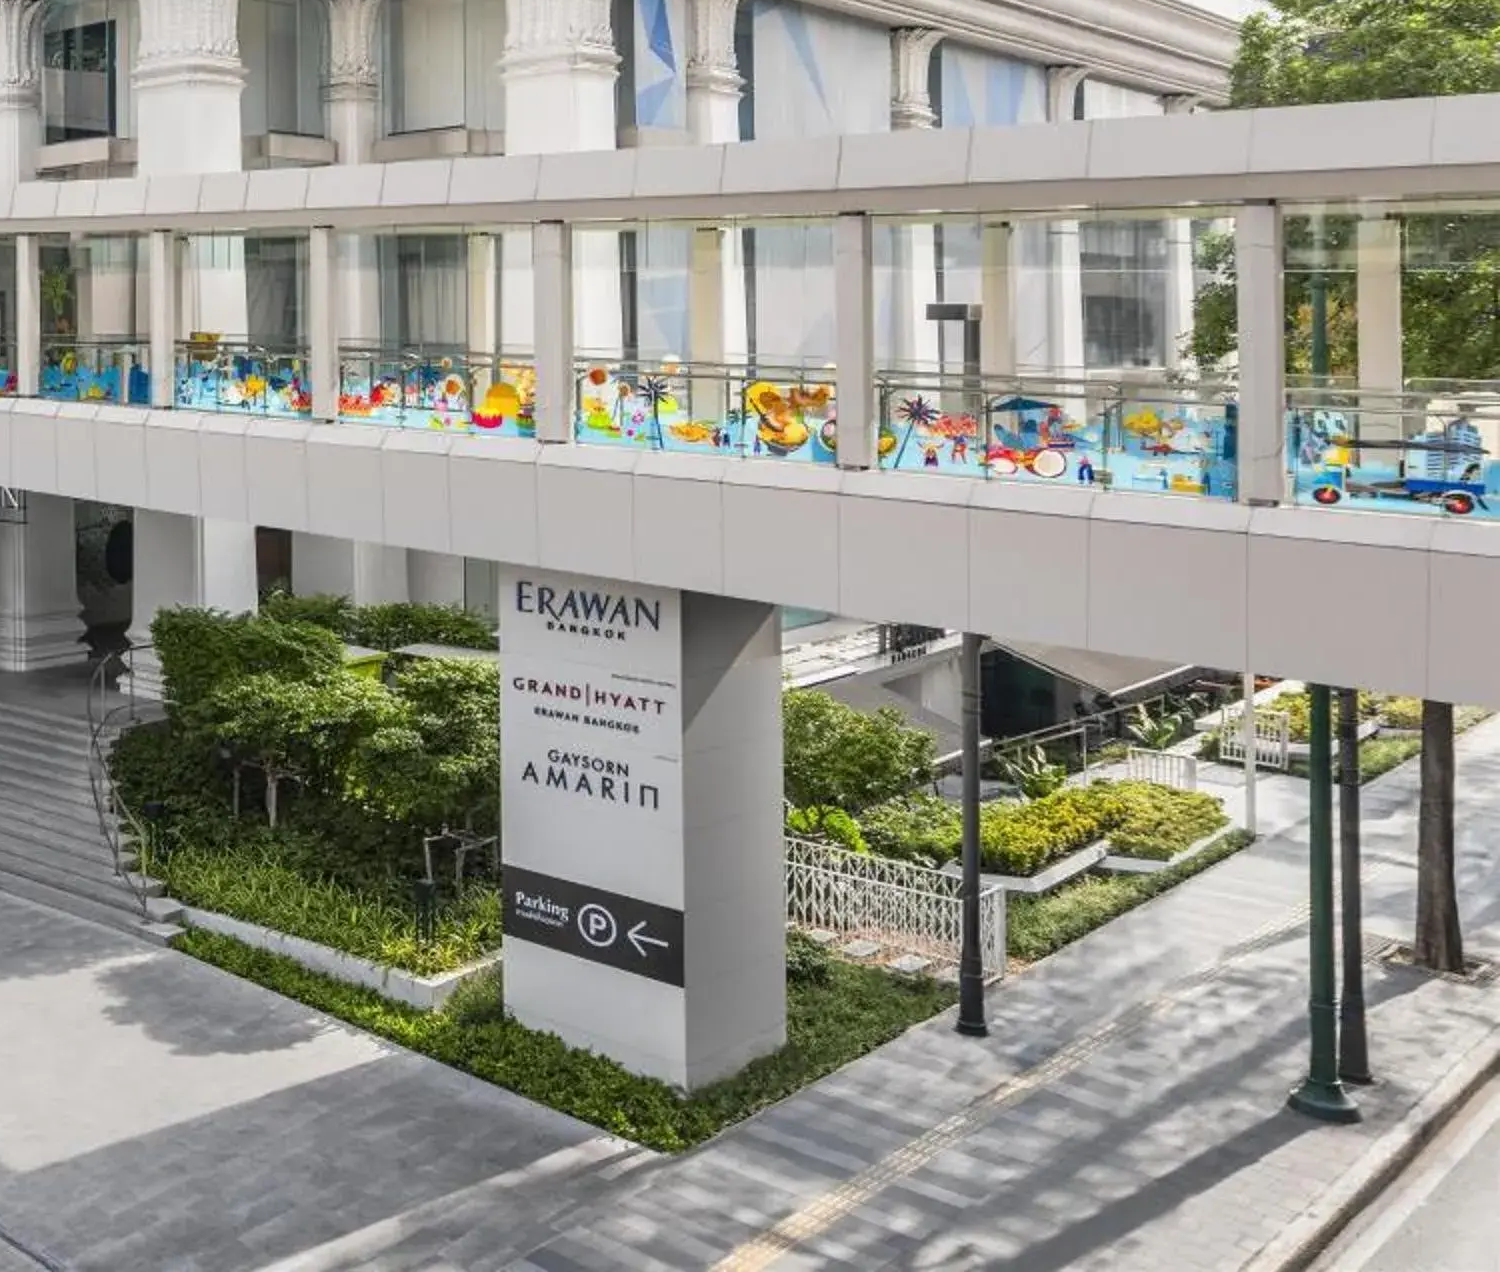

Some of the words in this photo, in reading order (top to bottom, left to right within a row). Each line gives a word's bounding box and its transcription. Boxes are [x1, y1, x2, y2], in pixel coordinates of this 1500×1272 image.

[516, 581, 660, 632] ERAWAN
[547, 621, 626, 641] BANGKOK
[534, 706, 579, 723] ERAWAN
[583, 715, 640, 735] BANGKOK
[547, 749, 629, 777] GAYSORN
[515, 891, 569, 922] Parking
